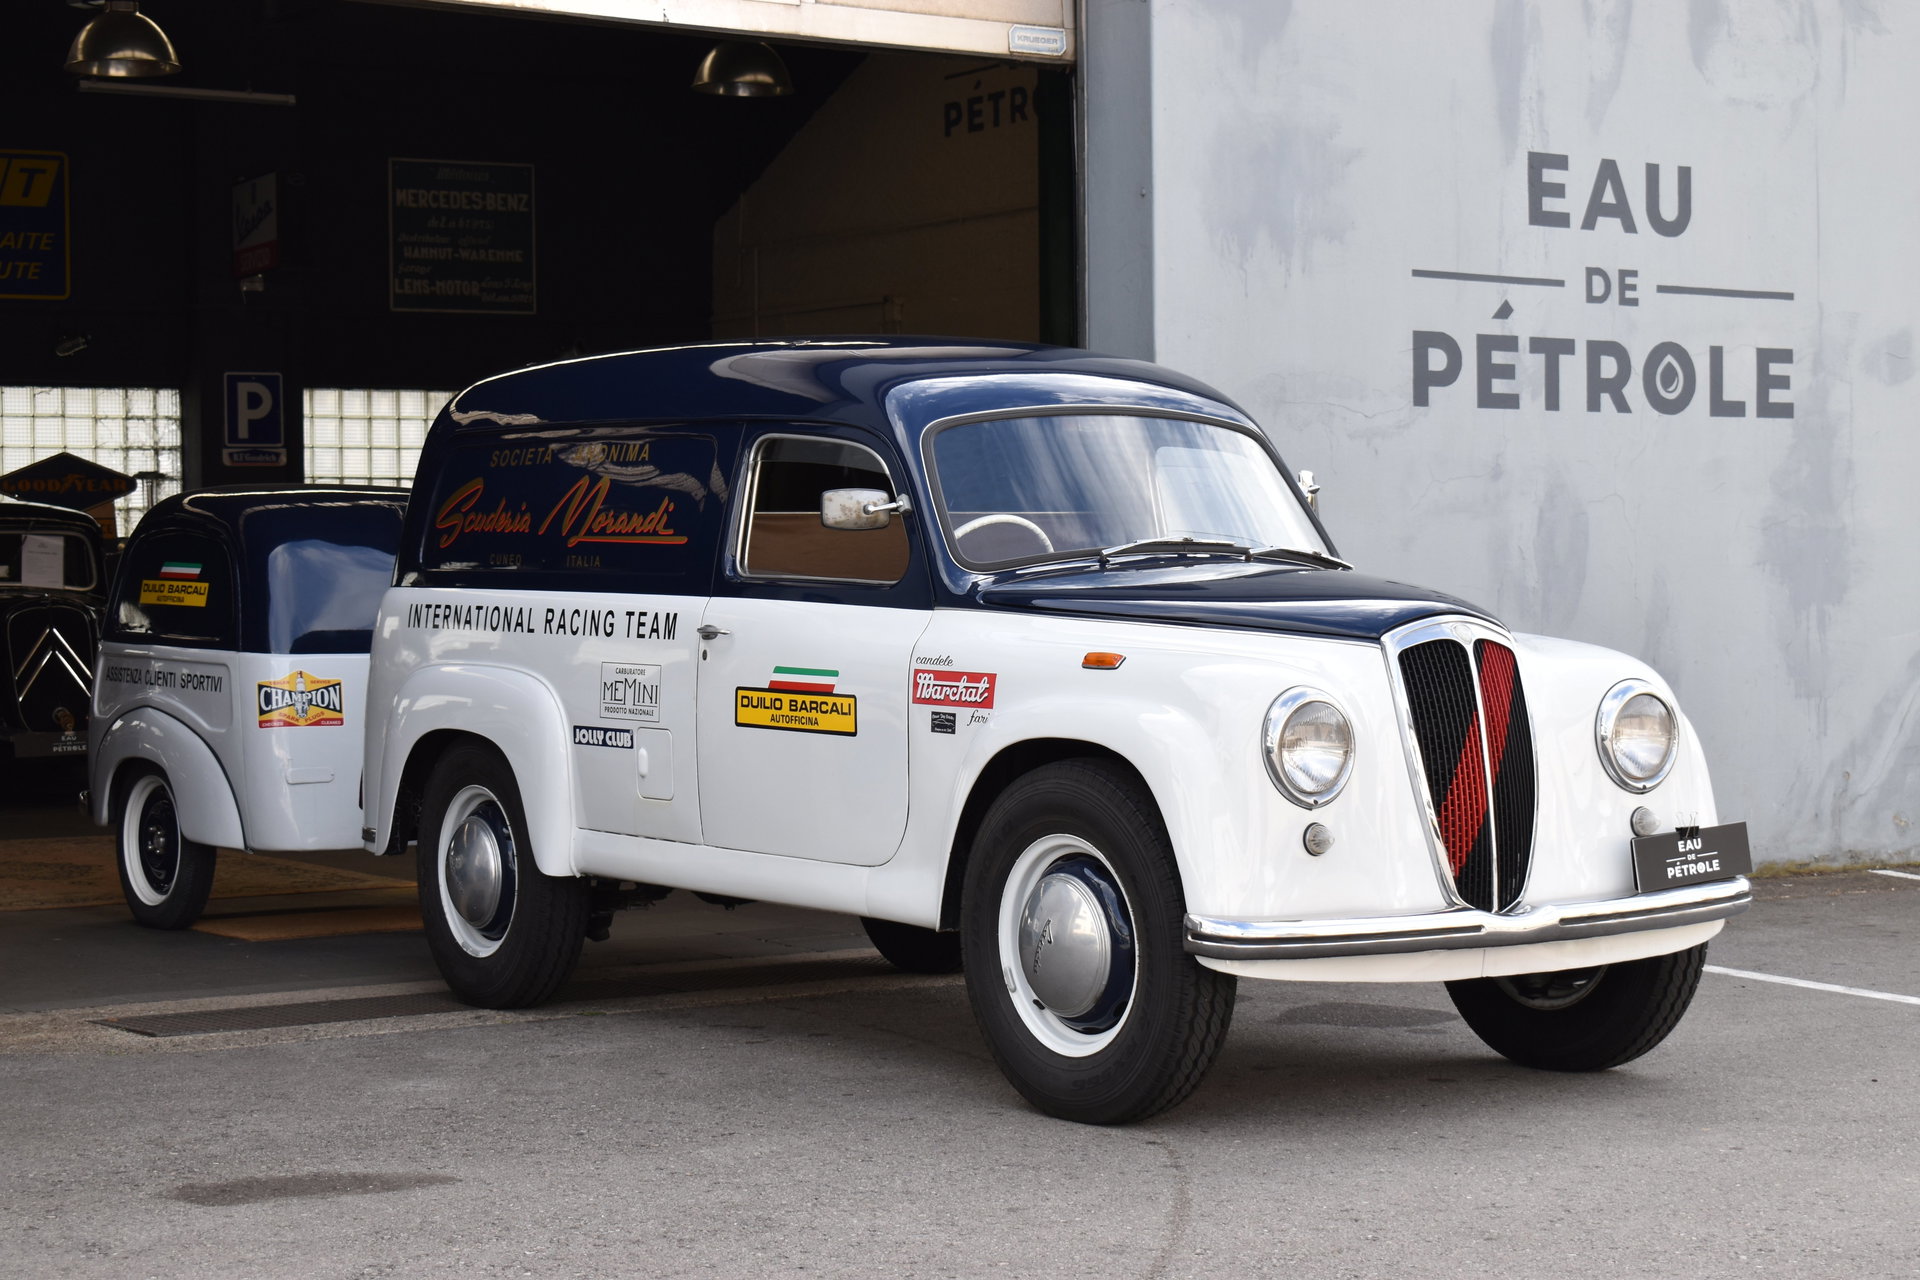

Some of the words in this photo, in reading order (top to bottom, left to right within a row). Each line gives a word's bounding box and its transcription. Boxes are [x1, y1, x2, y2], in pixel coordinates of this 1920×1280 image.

[944, 79, 1039, 138] PÉTR
[396, 188, 529, 212] MERCEDES-BENZ
[1527, 151, 1692, 238] EAU
[1585, 266, 1639, 307] DE
[1412, 298, 1795, 419] PÉTROLE
[236, 381, 273, 440] P
[435, 476, 532, 549] Scuderia
[538, 474, 688, 548] Morandi
[489, 553, 522, 566] CUNEO
[566, 555, 601, 568] ITALIA
[167, 584, 207, 596] BARCALI
[407, 603, 535, 634] INTERNATIONAL
[544, 608, 615, 638] RACING
[625, 611, 678, 641] TEAM
[916, 655, 954, 667] candele
[105, 666, 143, 684] ASSISTENZA
[144, 670, 177, 688] CLIENTI
[180, 673, 223, 693] SPORTIVI
[615, 667, 646, 676] CARBURATORE
[259, 685, 341, 712] CHAMPION
[603, 678, 659, 705] MEMINI
[604, 706, 627, 715] PRODOTTO
[628, 709, 655, 717] NAZIONALE
[740, 696, 783, 711] DUILIO
[789, 699, 852, 716] BARCALI
[769, 713, 820, 726] AUTOFFICINA
[966, 709, 991, 727] fari
[574, 728, 605, 746] JOLLY
[605, 731, 633, 748] CLUB
[1677, 837, 1702, 853] EAU
[1686, 853, 1696, 861] DE
[1666, 859, 1721, 879] PÉTROLE
